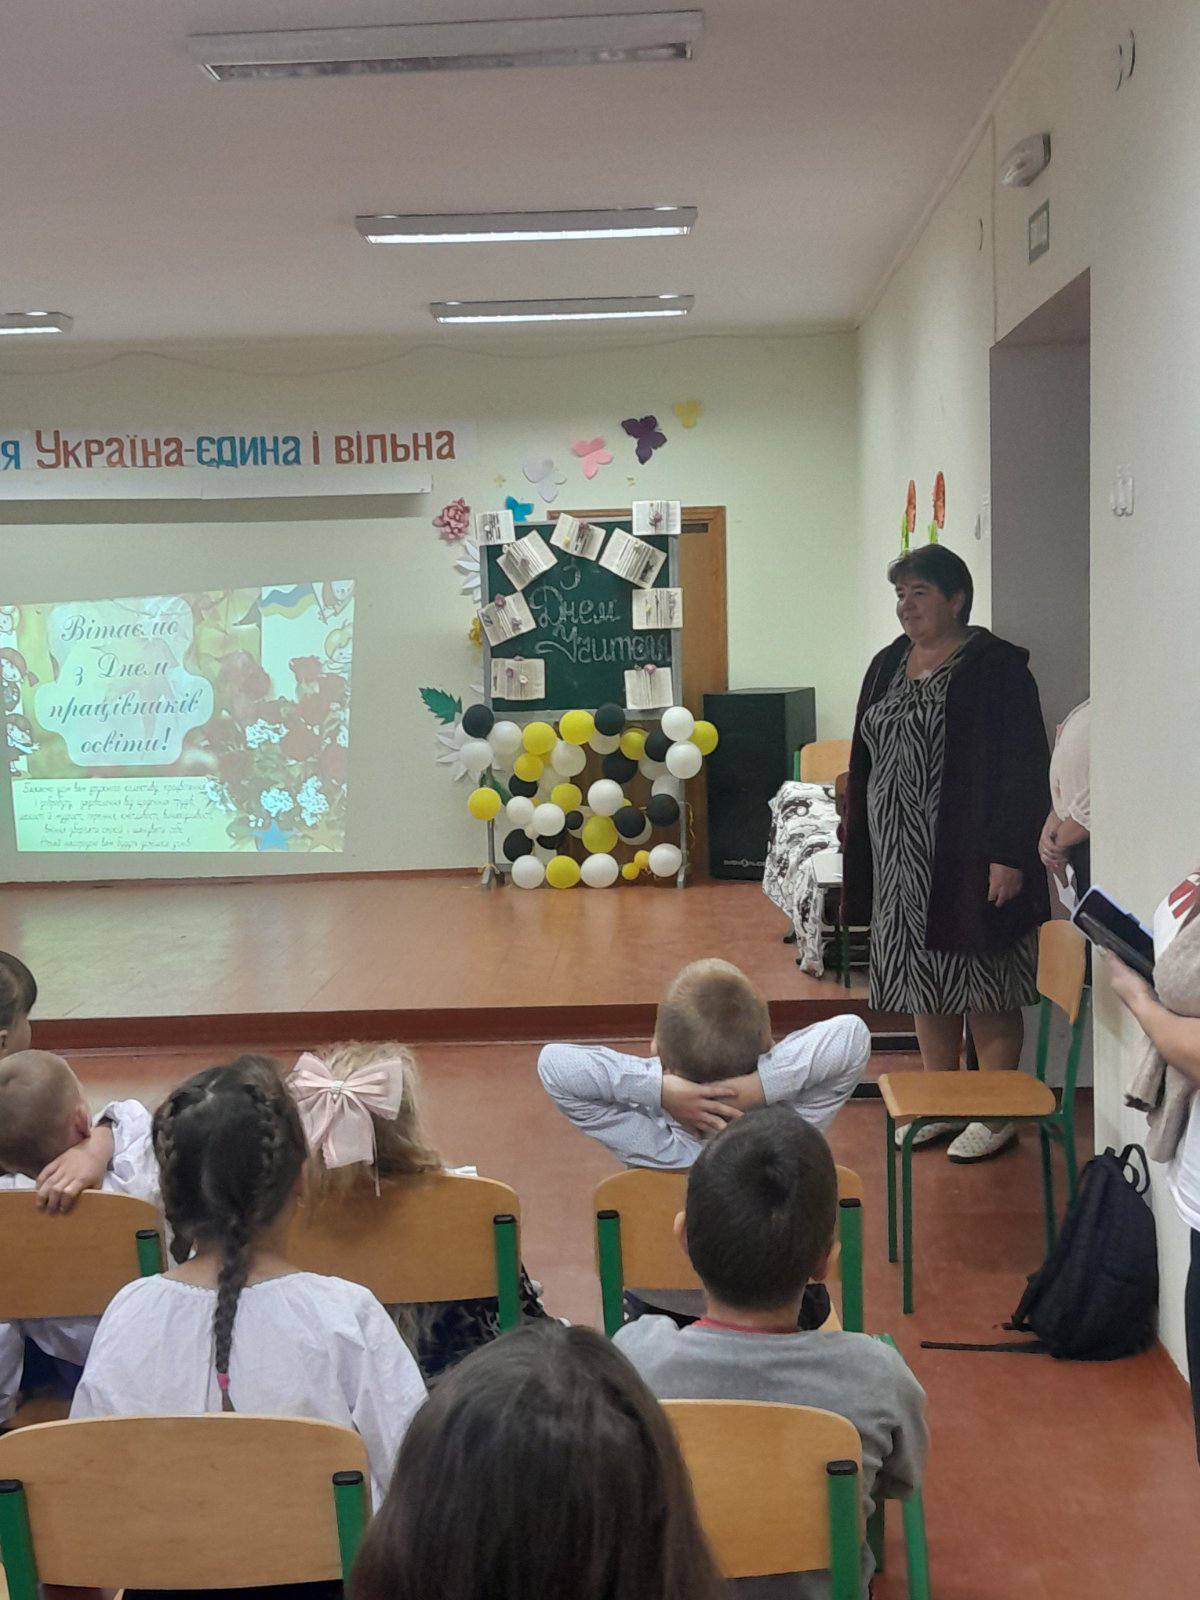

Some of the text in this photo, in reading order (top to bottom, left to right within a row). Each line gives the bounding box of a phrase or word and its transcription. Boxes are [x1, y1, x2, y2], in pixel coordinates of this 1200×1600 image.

[1, 429, 456, 470] я Україна-єдина і вільна
[528, 585, 621, 628] Днем
[61, 615, 178, 642] Вітаємо
[92, 647, 168, 678] Днем
[49, 689, 203, 724] працівників
[81, 727, 171, 753] освіти!
